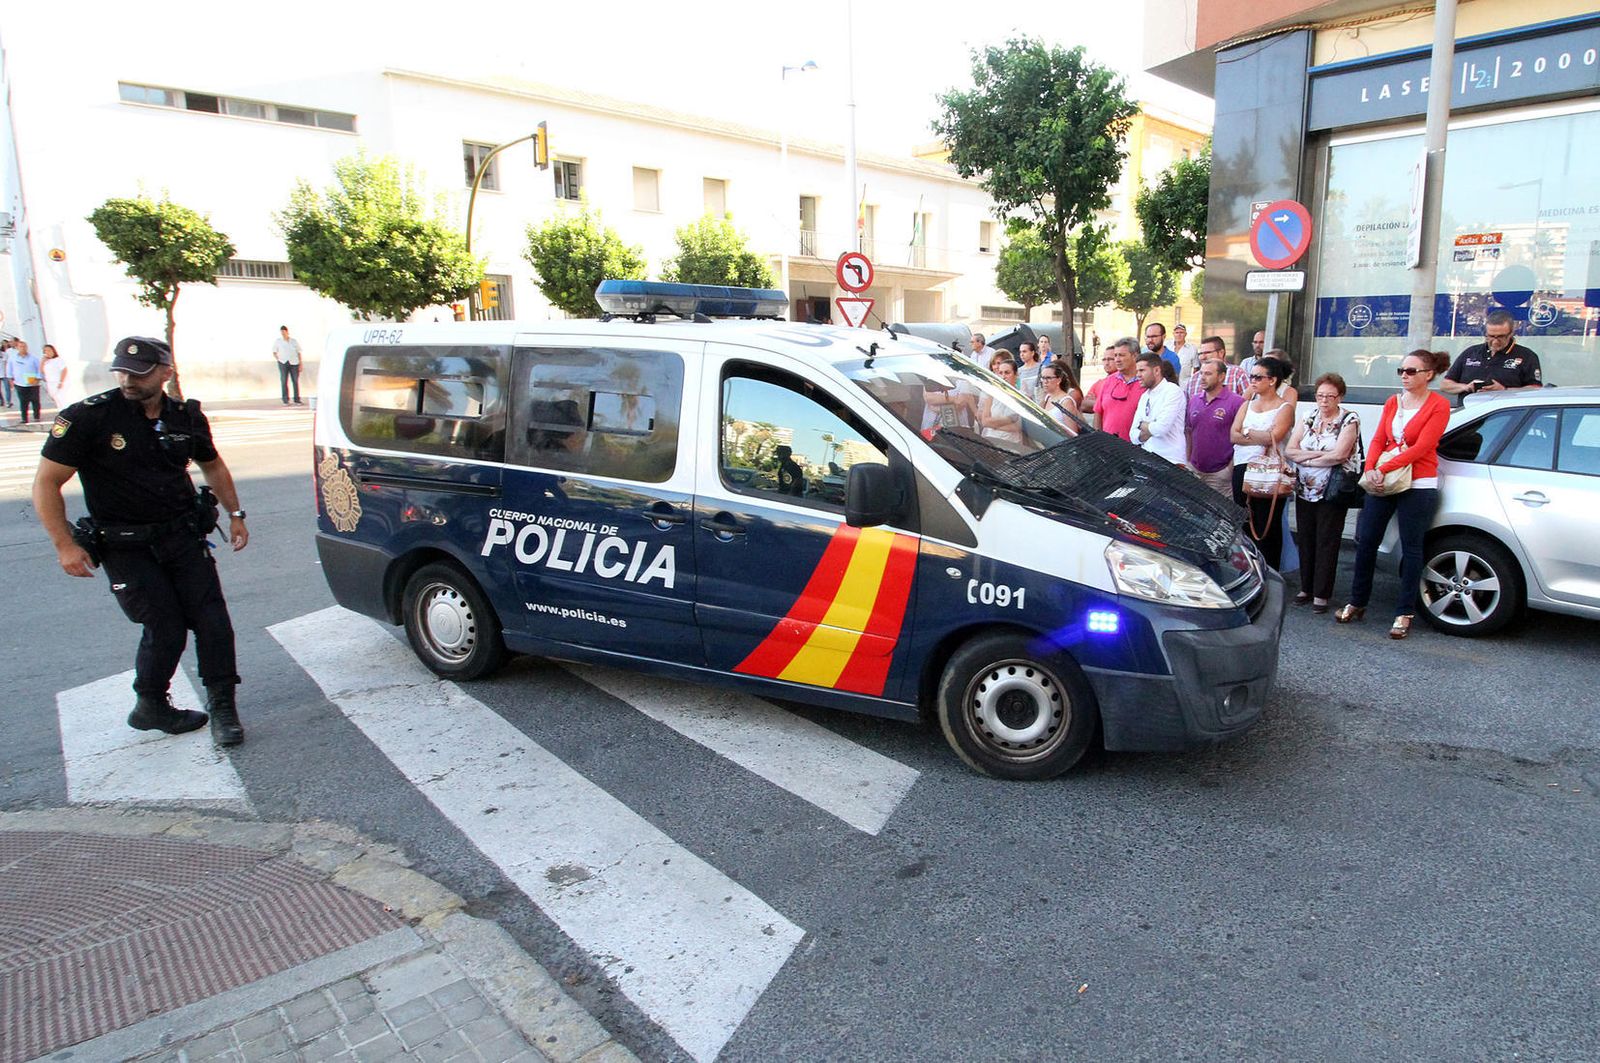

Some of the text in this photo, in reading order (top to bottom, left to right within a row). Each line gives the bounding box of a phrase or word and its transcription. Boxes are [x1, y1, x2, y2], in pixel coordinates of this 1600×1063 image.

[1361, 48, 1596, 102] LASE 2000
[1538, 207, 1585, 217] MEDICINA
[363, 329, 404, 345] UPR-62
[489, 508, 619, 536] CUERPO NACIONAL DE
[480, 518, 676, 589] POLICIA
[980, 582, 1026, 609] 091
[525, 602, 628, 628] www.policia.es
